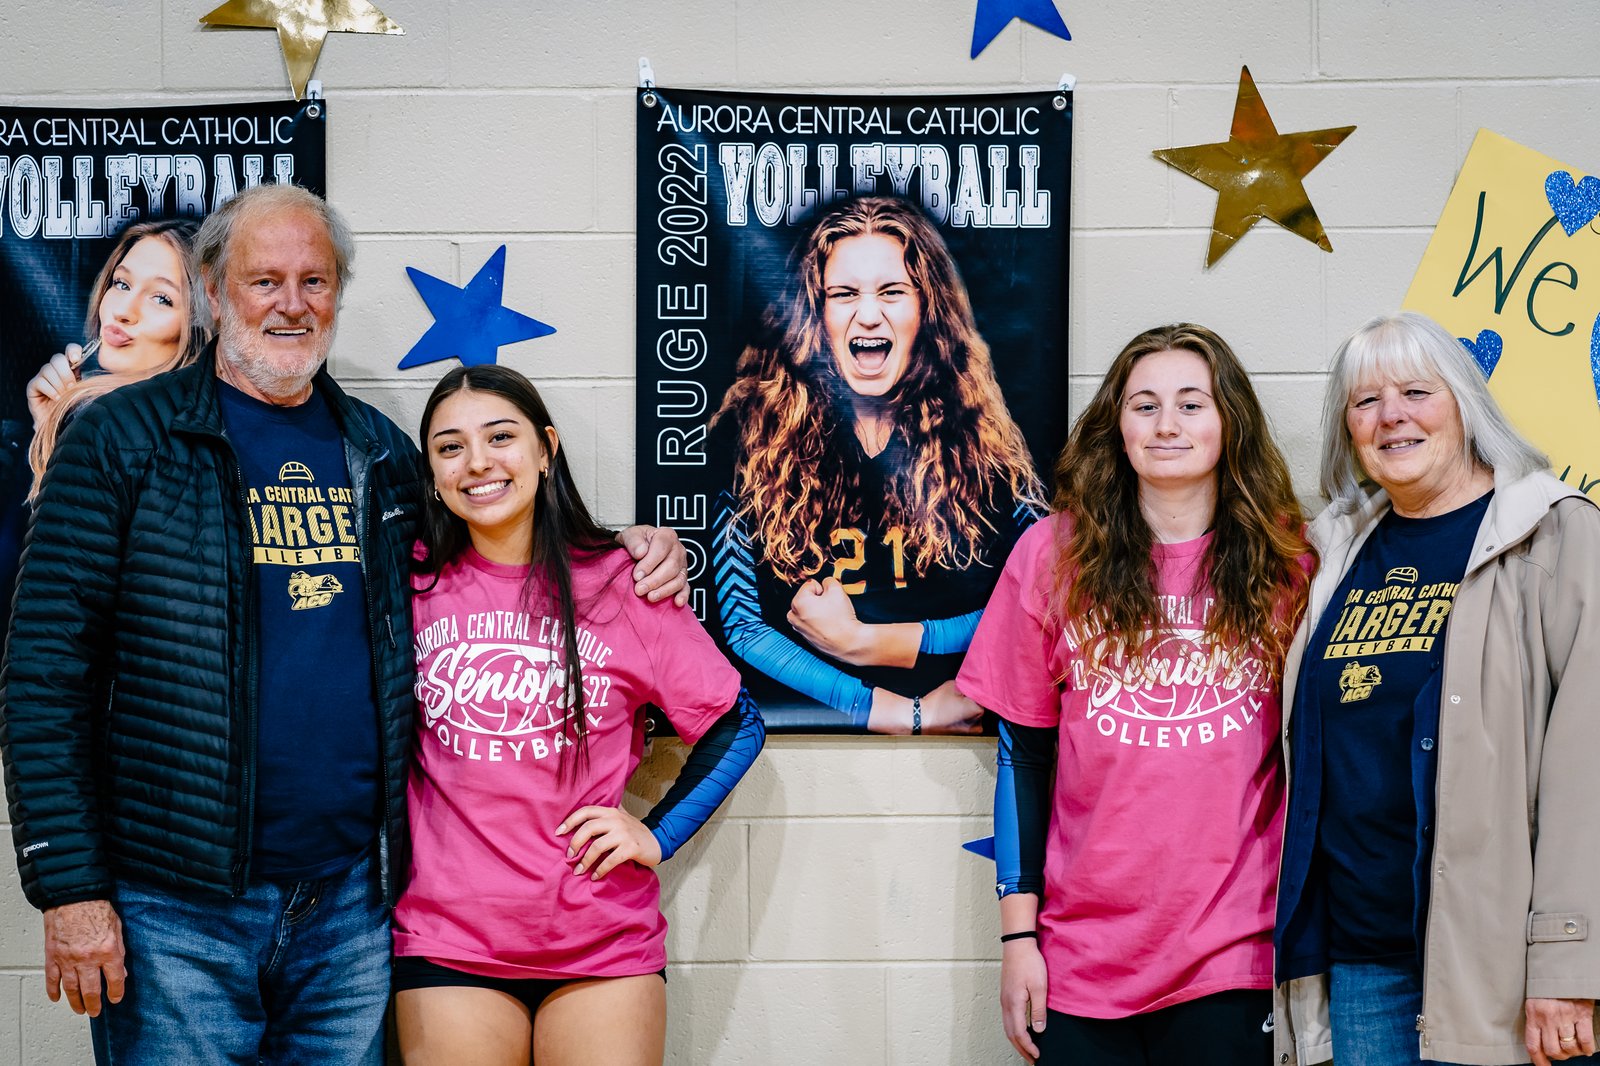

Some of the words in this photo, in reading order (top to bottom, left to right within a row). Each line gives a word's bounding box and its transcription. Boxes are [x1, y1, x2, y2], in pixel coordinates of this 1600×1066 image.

[33, 117, 156, 147] CENTRAL
[161, 116, 293, 146] CATHOLIC
[657, 104, 774, 134] AURORA
[778, 106, 901, 136] CENTRAL
[907, 107, 1040, 136] CATHOLIC
[0, 153, 294, 239] OLLEYBA
[657, 143, 708, 266] 2022
[718, 142, 1051, 229] VOLLEYBALL
[1452, 191, 1579, 337] We
[656, 283, 708, 466] RUGE
[247, 487, 261, 504] A
[264, 485, 325, 504] CENTRAL
[327, 486, 353, 503] CAT
[249, 504, 357, 546] ARGE
[829, 527, 907, 595] 21
[1365, 585, 1417, 605] CENTRAL
[413, 614, 459, 666] AURORA
[467, 610, 530, 641] CENTRAL
[589, 676, 611, 707] 22
[1086, 696, 1263, 748] VOLLEYBALL
